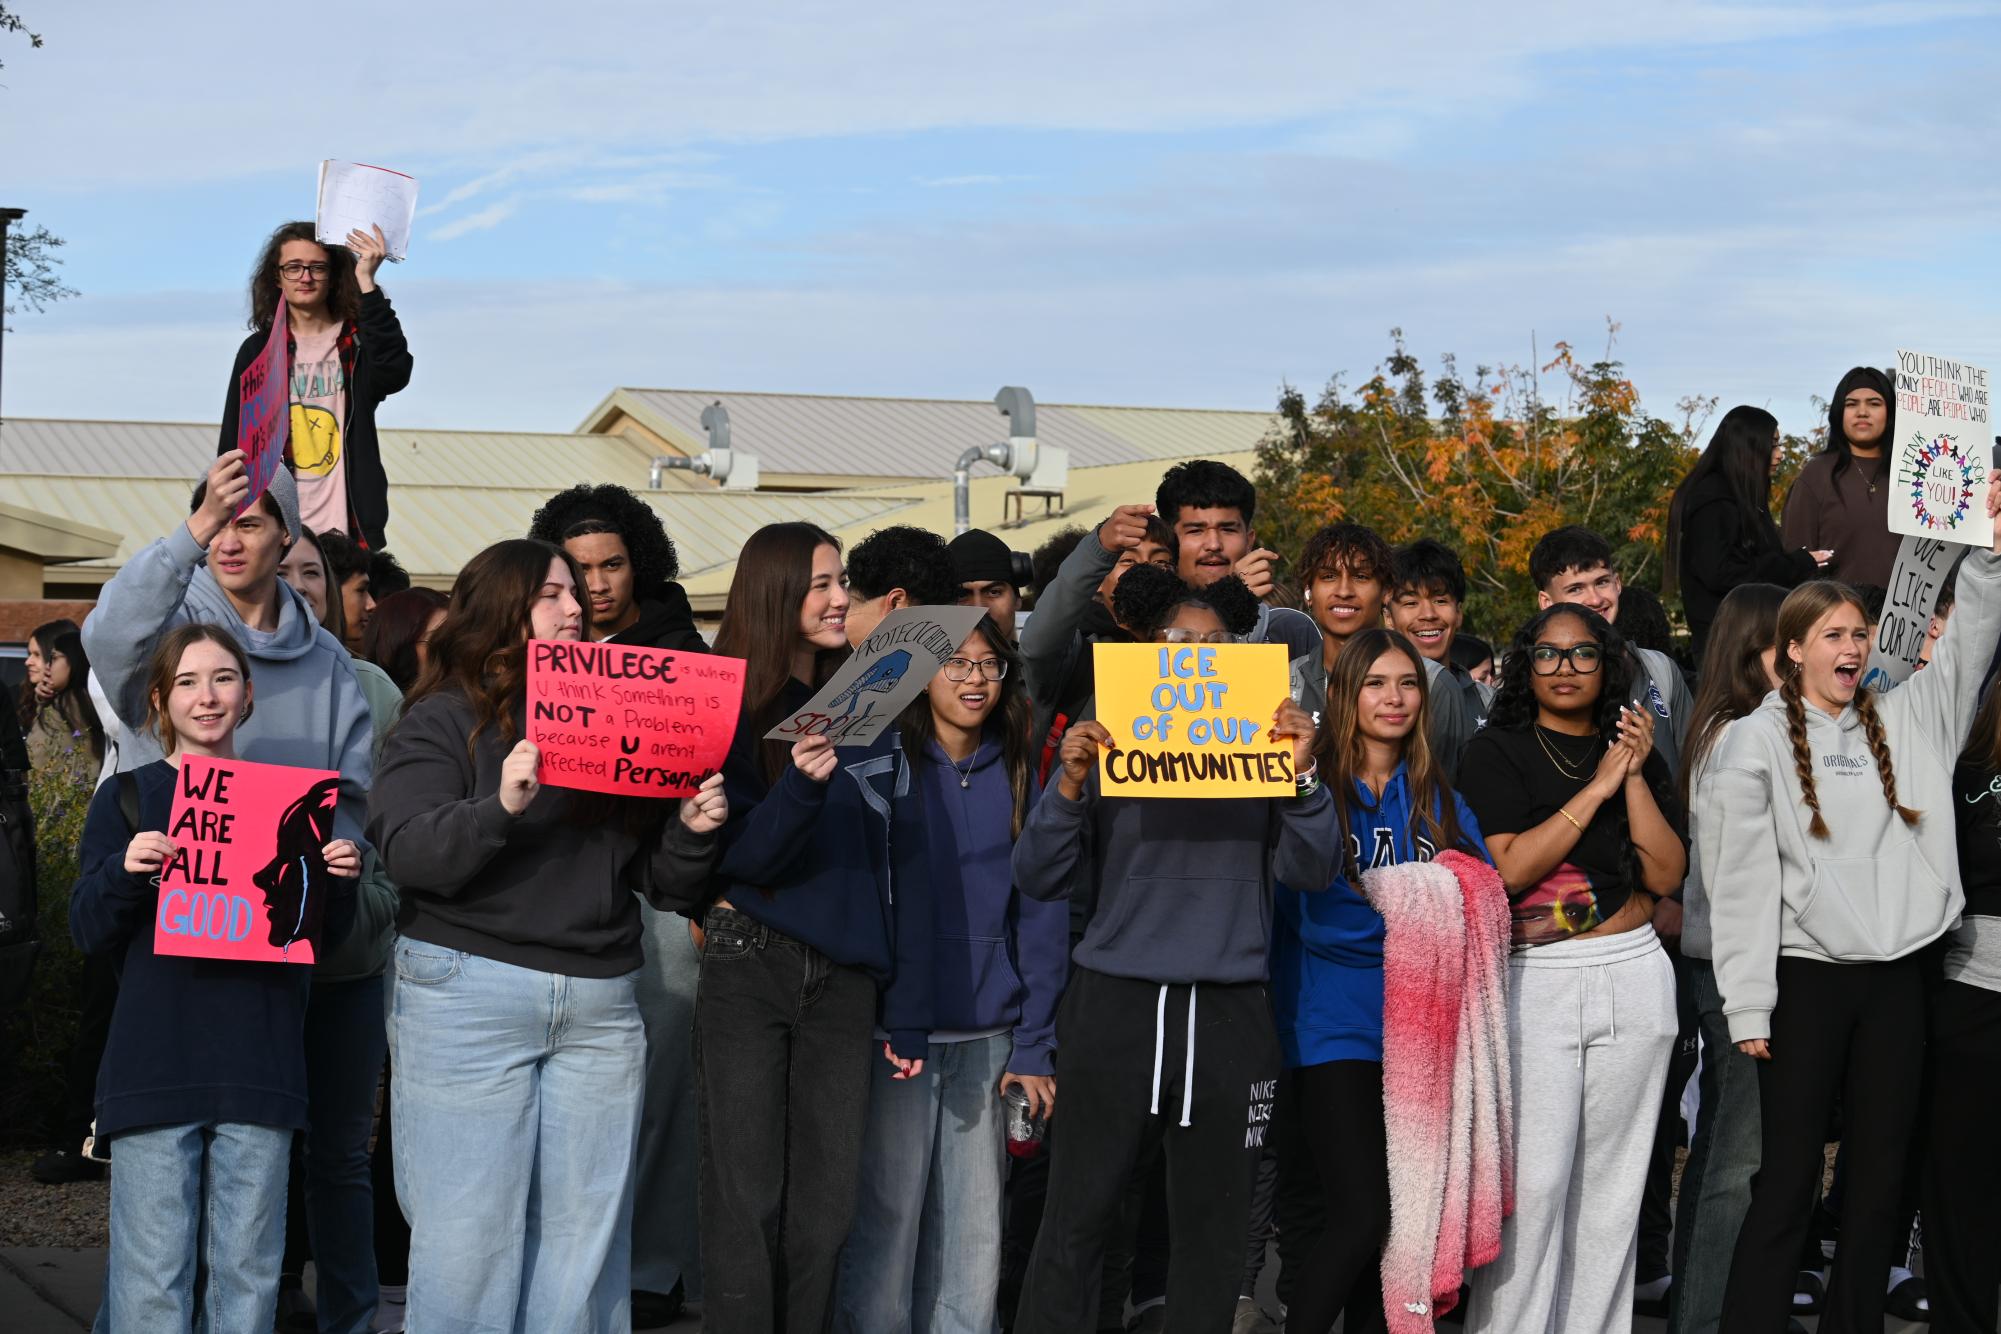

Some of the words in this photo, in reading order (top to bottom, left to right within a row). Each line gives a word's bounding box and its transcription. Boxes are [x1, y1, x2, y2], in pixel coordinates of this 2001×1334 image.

[1897, 350, 1925, 376] YOU
[1927, 356, 1962, 382] THINK
[1964, 366, 1988, 387] THE
[1896, 373, 1919, 393] ONLY
[1921, 377, 1957, 401] PEOPLE
[1957, 384, 1973, 403] WHO
[1974, 389, 1988, 406] ARE
[1928, 398, 1942, 417] ARE
[1943, 401, 1969, 421] PEOPLE
[1969, 405, 1987, 424] WHO
[1898, 430, 1927, 487] THINK
[1937, 432, 1958, 442] and
[1965, 444, 1986, 485] LOOK
[1932, 465, 1954, 481] LIKE
[1926, 481, 1956, 506] YOU!
[1914, 537, 1945, 571] WE
[1893, 561, 1933, 618] LIKE
[855, 621, 934, 662] PROTECT
[1879, 611, 1906, 657] OUR
[535, 643, 678, 684] PRIVILEGE
[679, 663, 691, 674] is
[696, 667, 737, 684] when
[1158, 647, 1218, 679] ICE
[557, 680, 607, 701] think
[705, 694, 721, 709] is
[1151, 682, 1229, 713] OUT
[534, 700, 596, 728] NOT
[605, 714, 615, 726] a
[535, 726, 610, 749] because
[183, 763, 235, 804] WE
[1105, 749, 1294, 784] COMMUNITIES
[171, 807, 235, 844] ARE
[162, 847, 229, 886] ALL
[159, 889, 253, 942] GOOD
[1250, 1079, 1277, 1102] NIKE
[1248, 1103, 1274, 1124] NIKE
